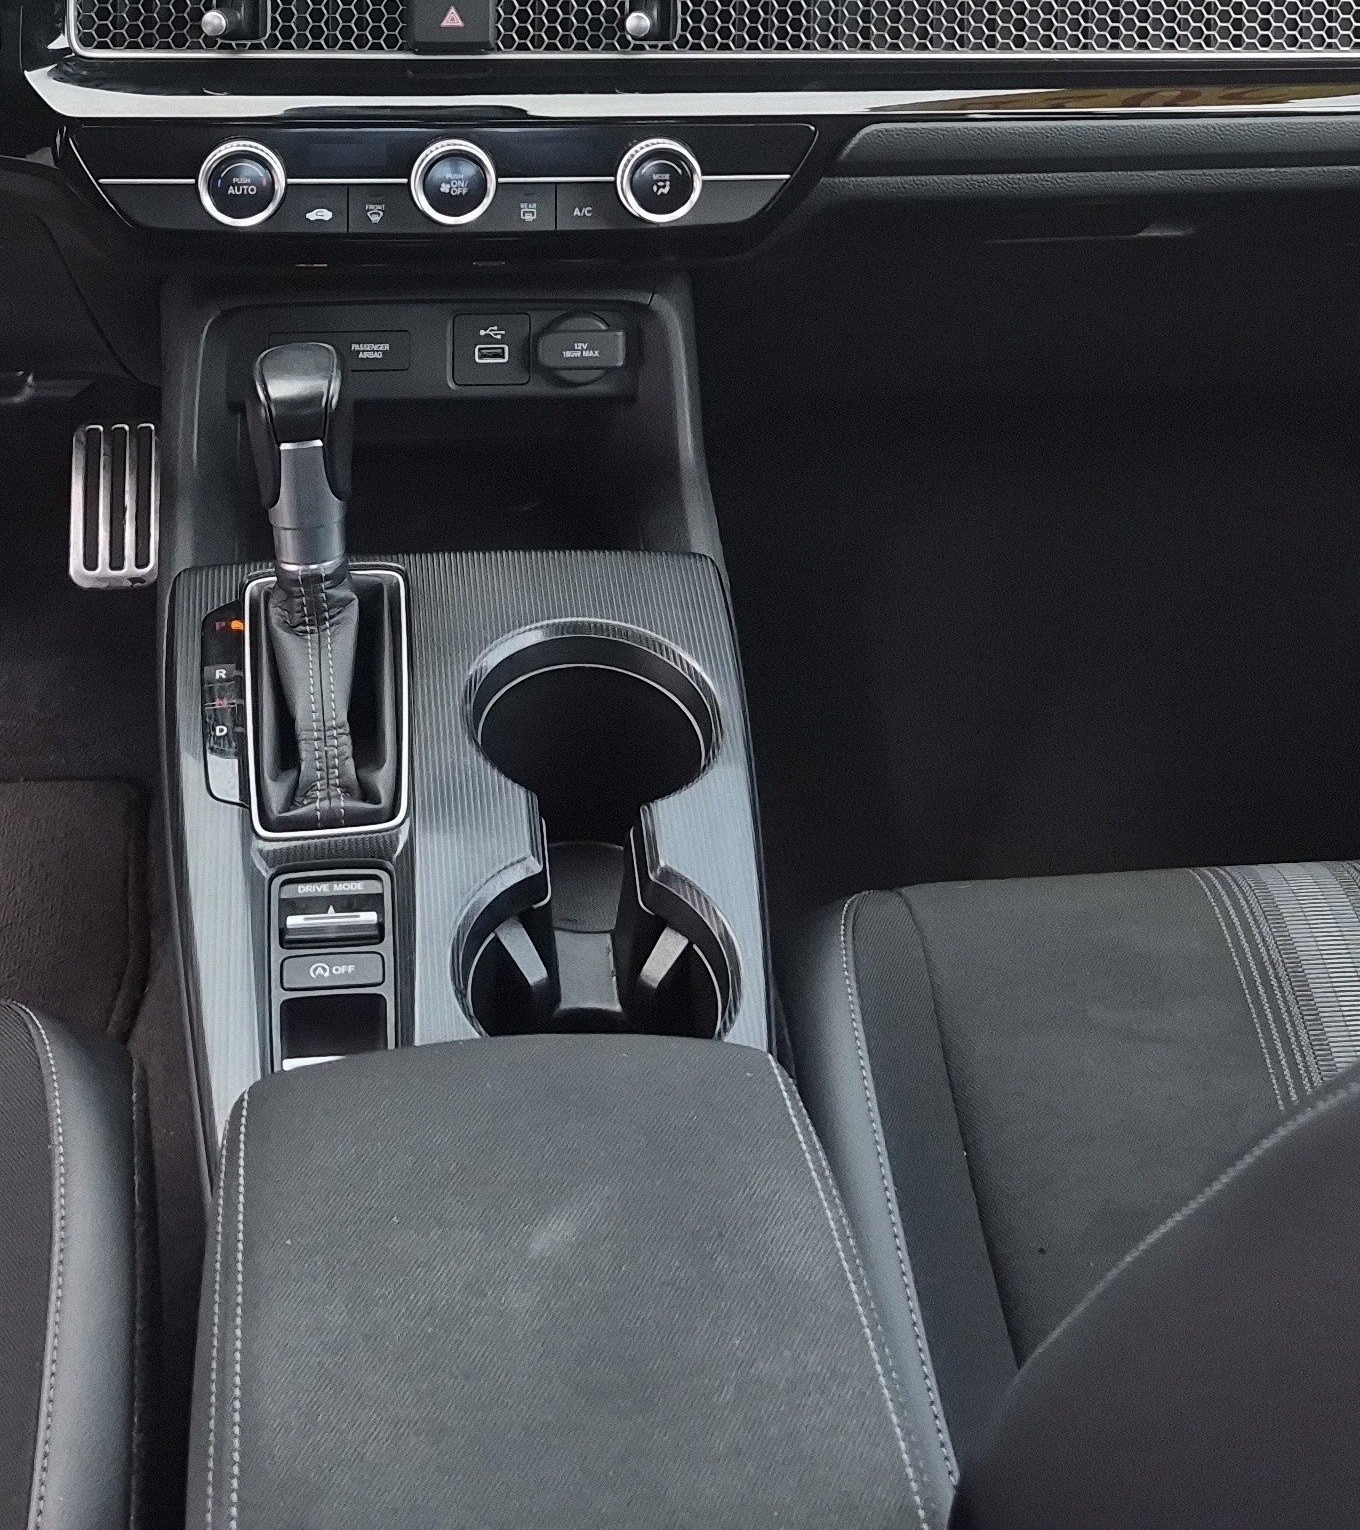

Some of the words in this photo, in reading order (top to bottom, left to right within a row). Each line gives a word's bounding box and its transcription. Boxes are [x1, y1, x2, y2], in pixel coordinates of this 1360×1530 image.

[451, 180, 469, 188] ON/
[228, 185, 257, 195] AUTO
[451, 188, 469, 196] OFF
[573, 207, 593, 217] A/C
[351, 343, 390, 351] PASSENGER
[358, 351, 383, 359] AIRBAG
[582, 350, 599, 358] MAX
[215, 668, 227, 680] R
[215, 725, 228, 737] D
[298, 883, 329, 894] DRIVE
[333, 882, 364, 892] MODE
[332, 964, 355, 975] OFF
